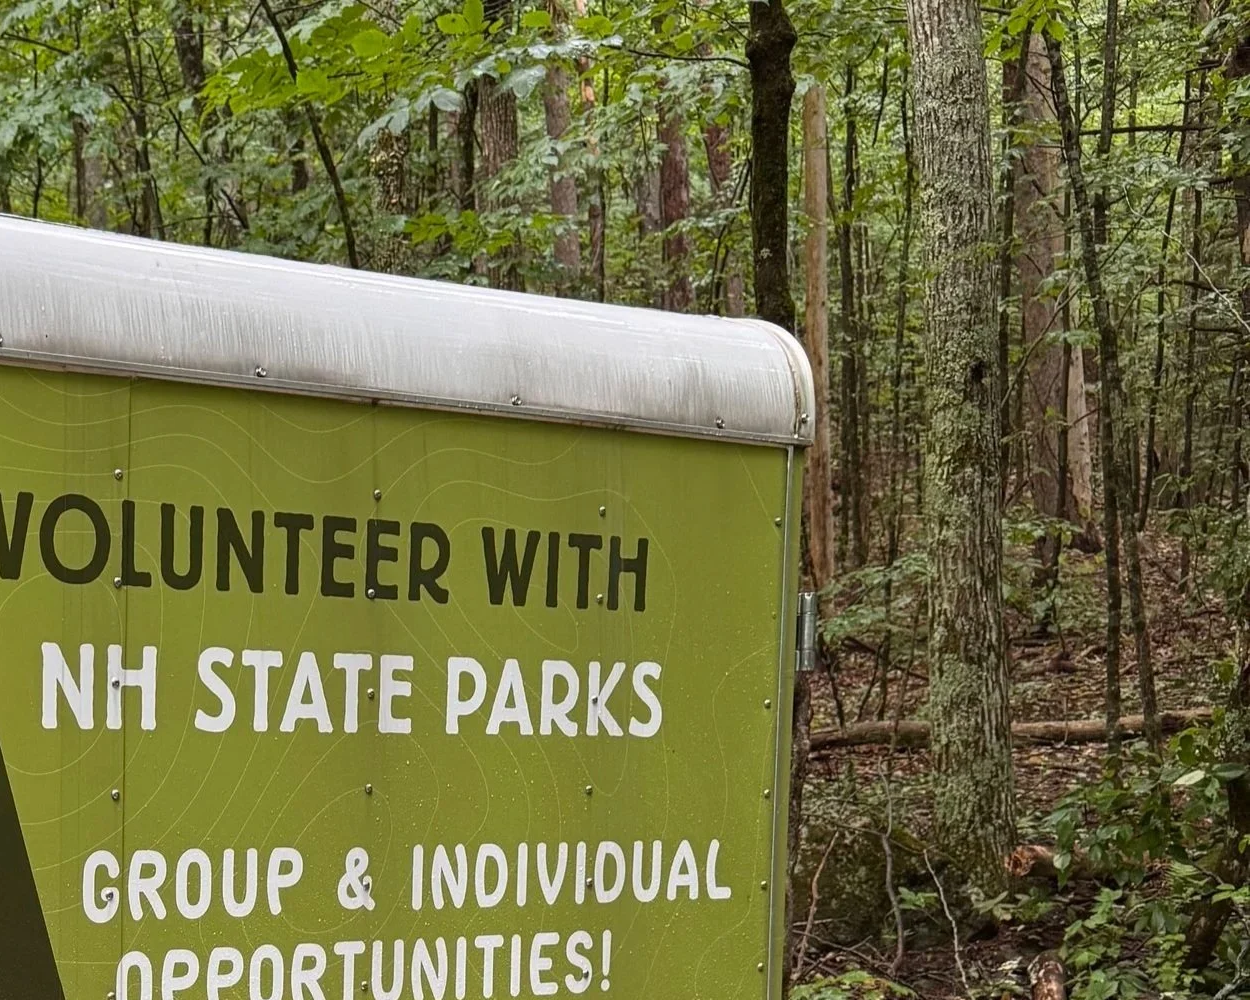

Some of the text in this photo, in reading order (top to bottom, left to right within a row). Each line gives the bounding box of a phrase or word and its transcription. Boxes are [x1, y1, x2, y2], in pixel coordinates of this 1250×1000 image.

[482, 527, 649, 612] WITH
[41, 642, 663, 738] NH STATE PARKS
[82, 839, 732, 924] GROUP & INDIVIDUAL
